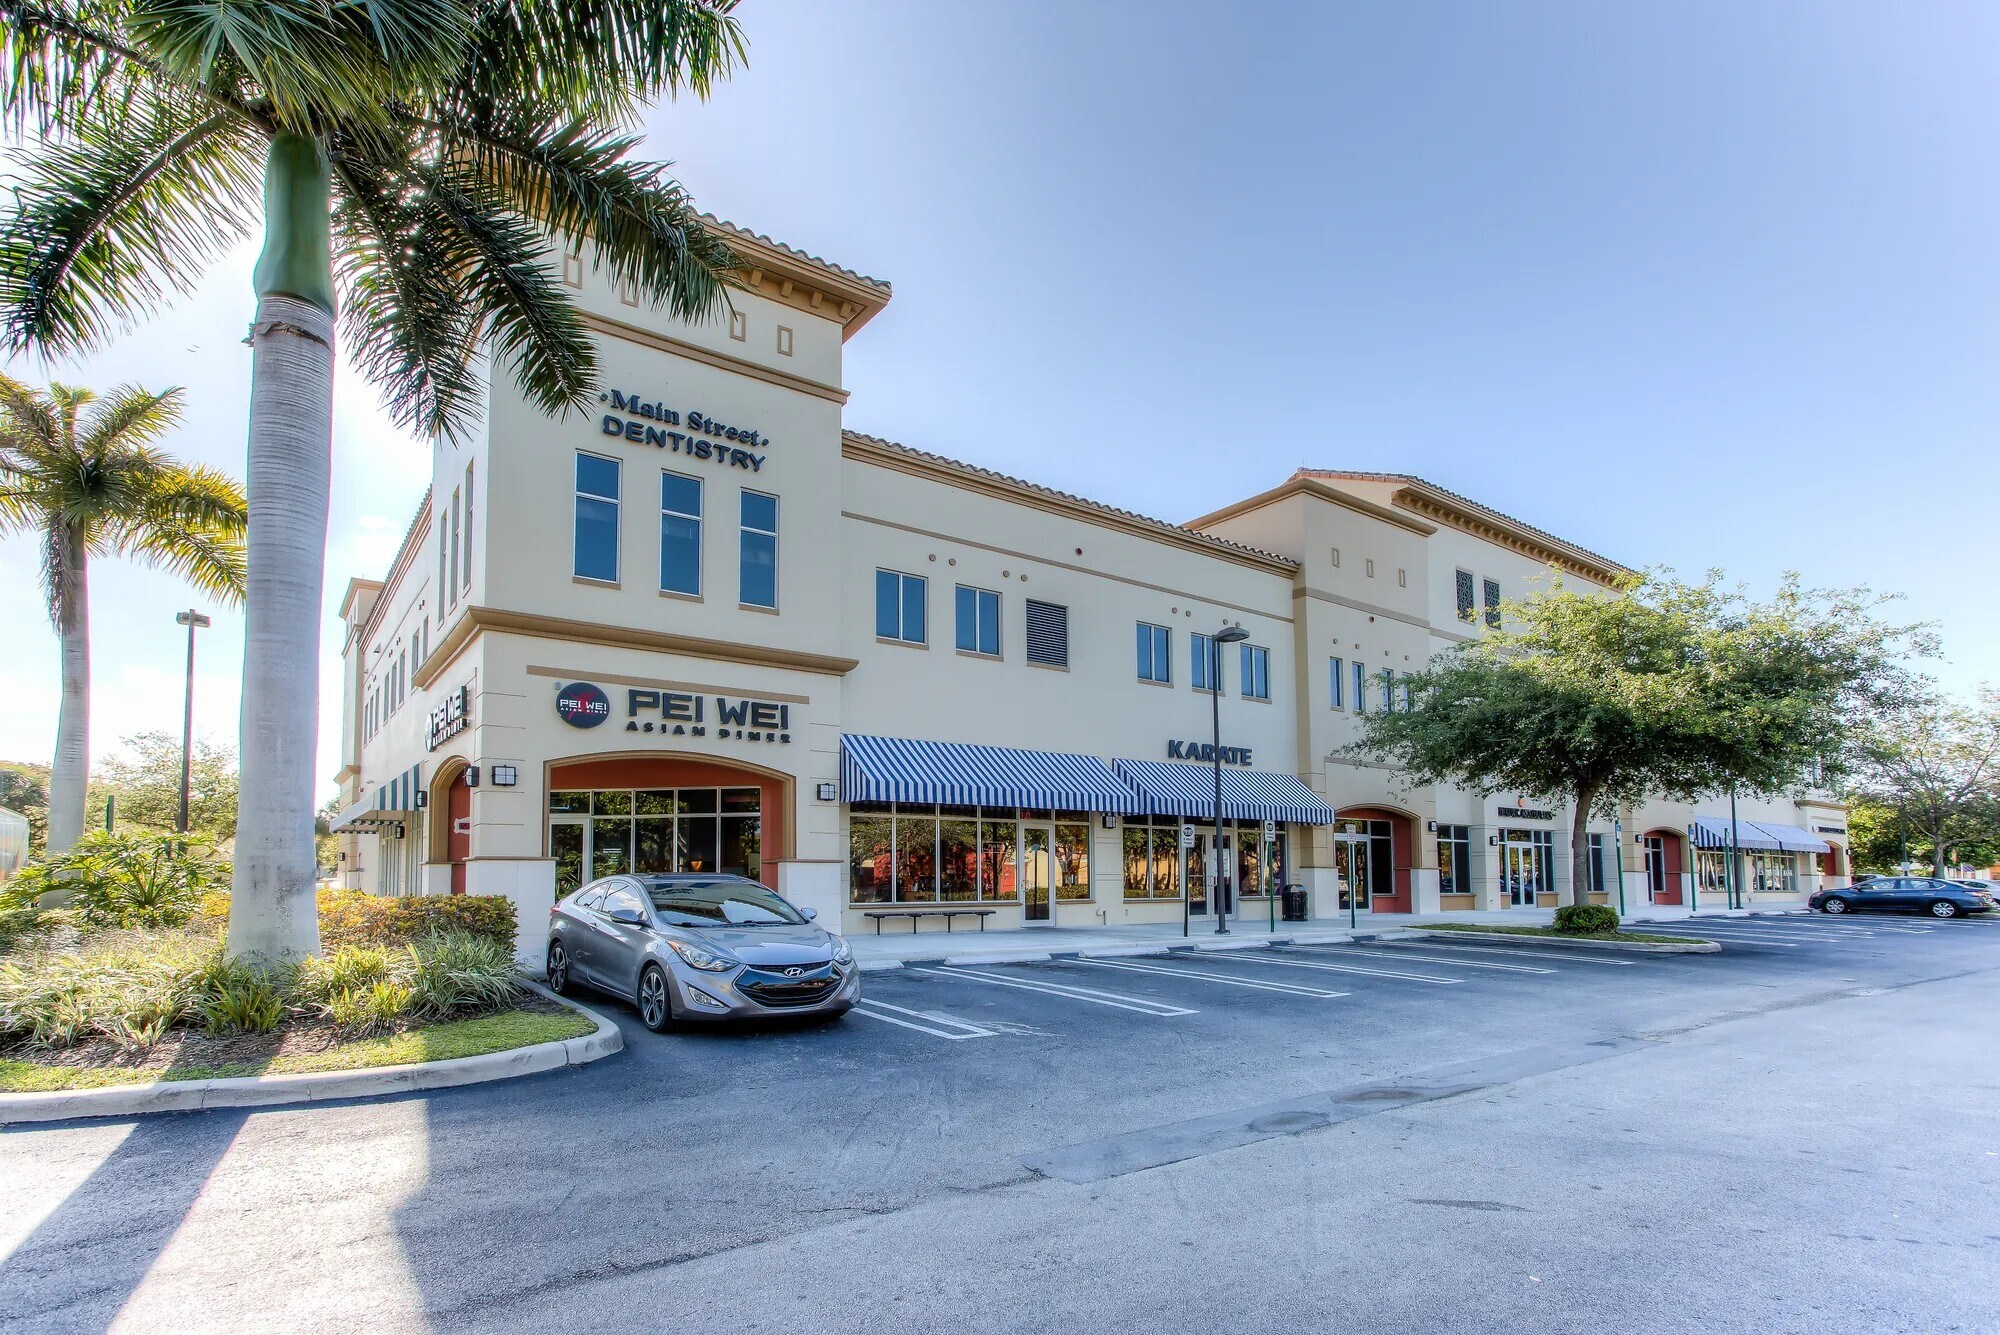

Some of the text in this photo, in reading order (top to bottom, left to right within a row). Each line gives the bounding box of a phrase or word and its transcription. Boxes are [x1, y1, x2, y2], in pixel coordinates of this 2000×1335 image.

[610, 389, 681, 425] Main
[602, 414, 766, 473] DENTISTRY
[560, 698, 607, 711] PEI WEI
[628, 689, 788, 730] PEI WEI
[625, 720, 792, 744] ASIAN DINER
[1168, 740, 1252, 765] KARATE
